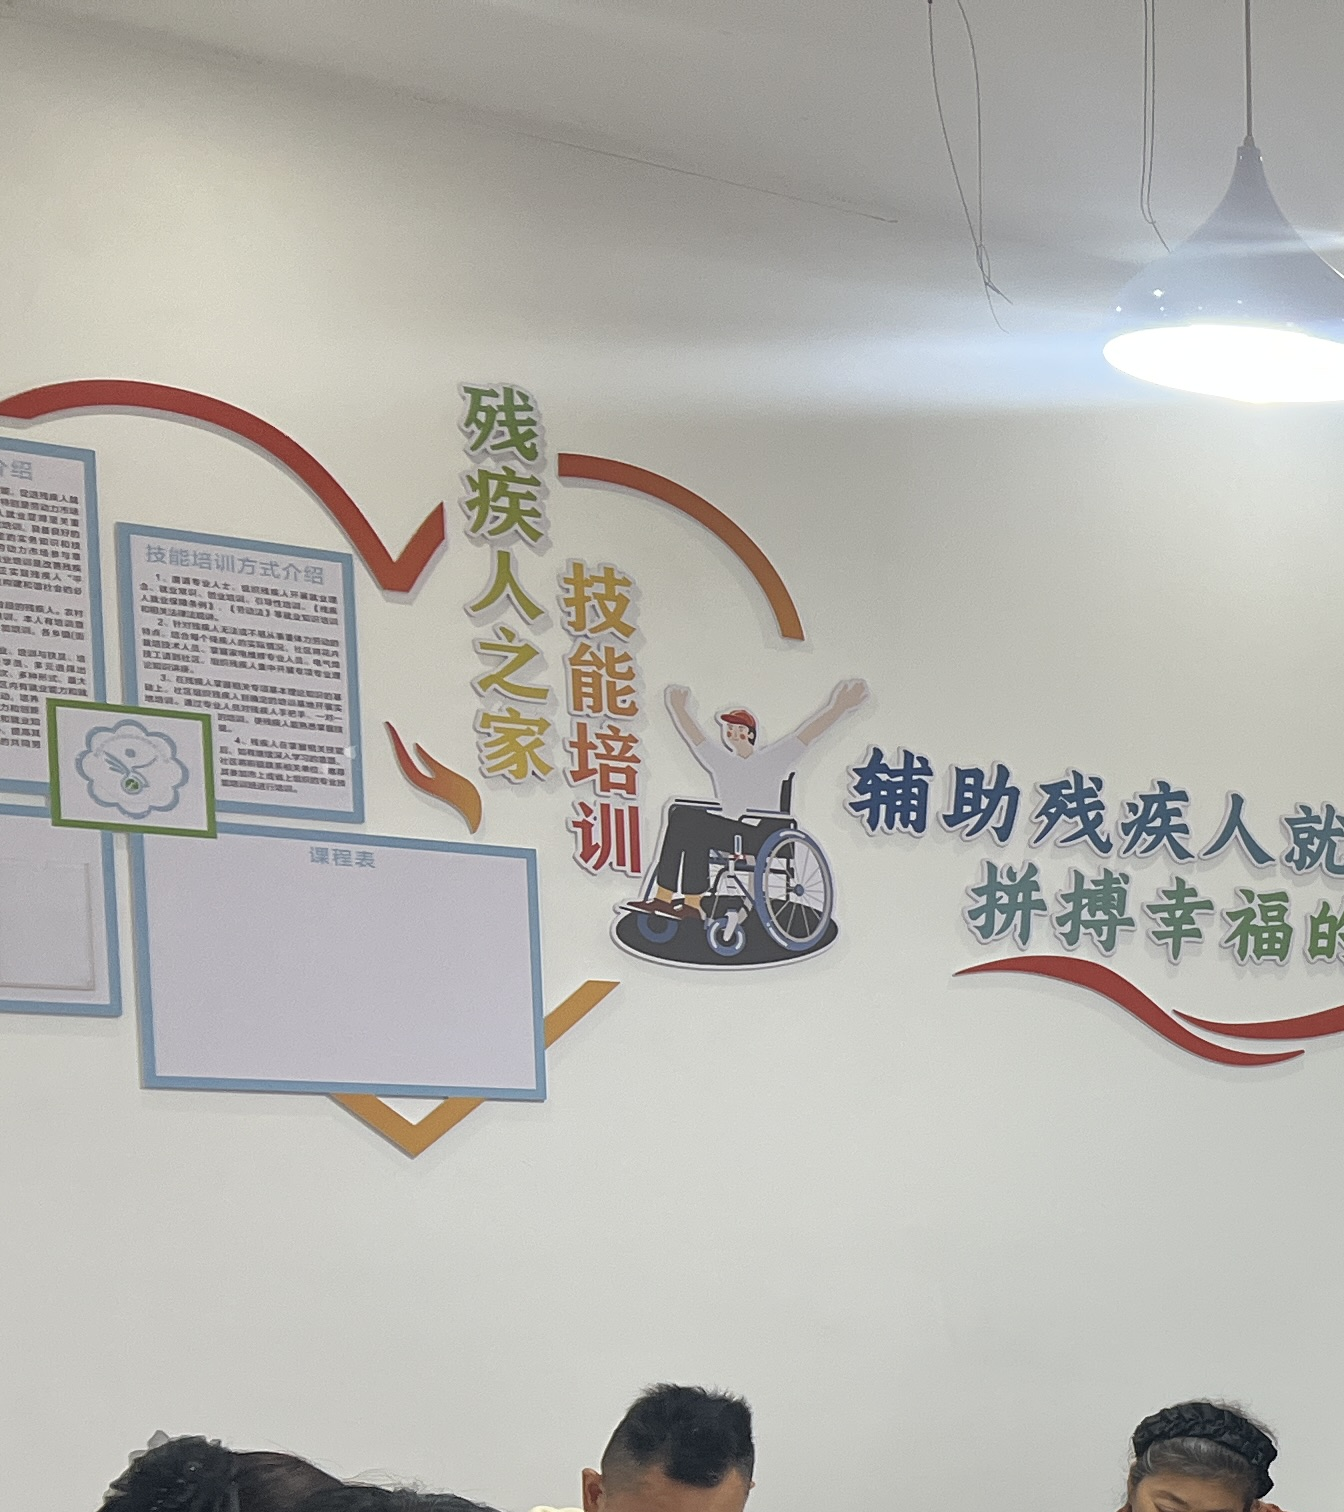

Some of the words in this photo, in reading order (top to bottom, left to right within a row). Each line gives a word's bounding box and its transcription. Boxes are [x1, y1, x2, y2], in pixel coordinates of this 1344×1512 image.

[145, 544, 324, 585] 技能培训方式介绍
[463, 384, 555, 782] 残疾人之家
[562, 562, 642, 875] 技能培训
[308, 847, 376, 869] 课程表
